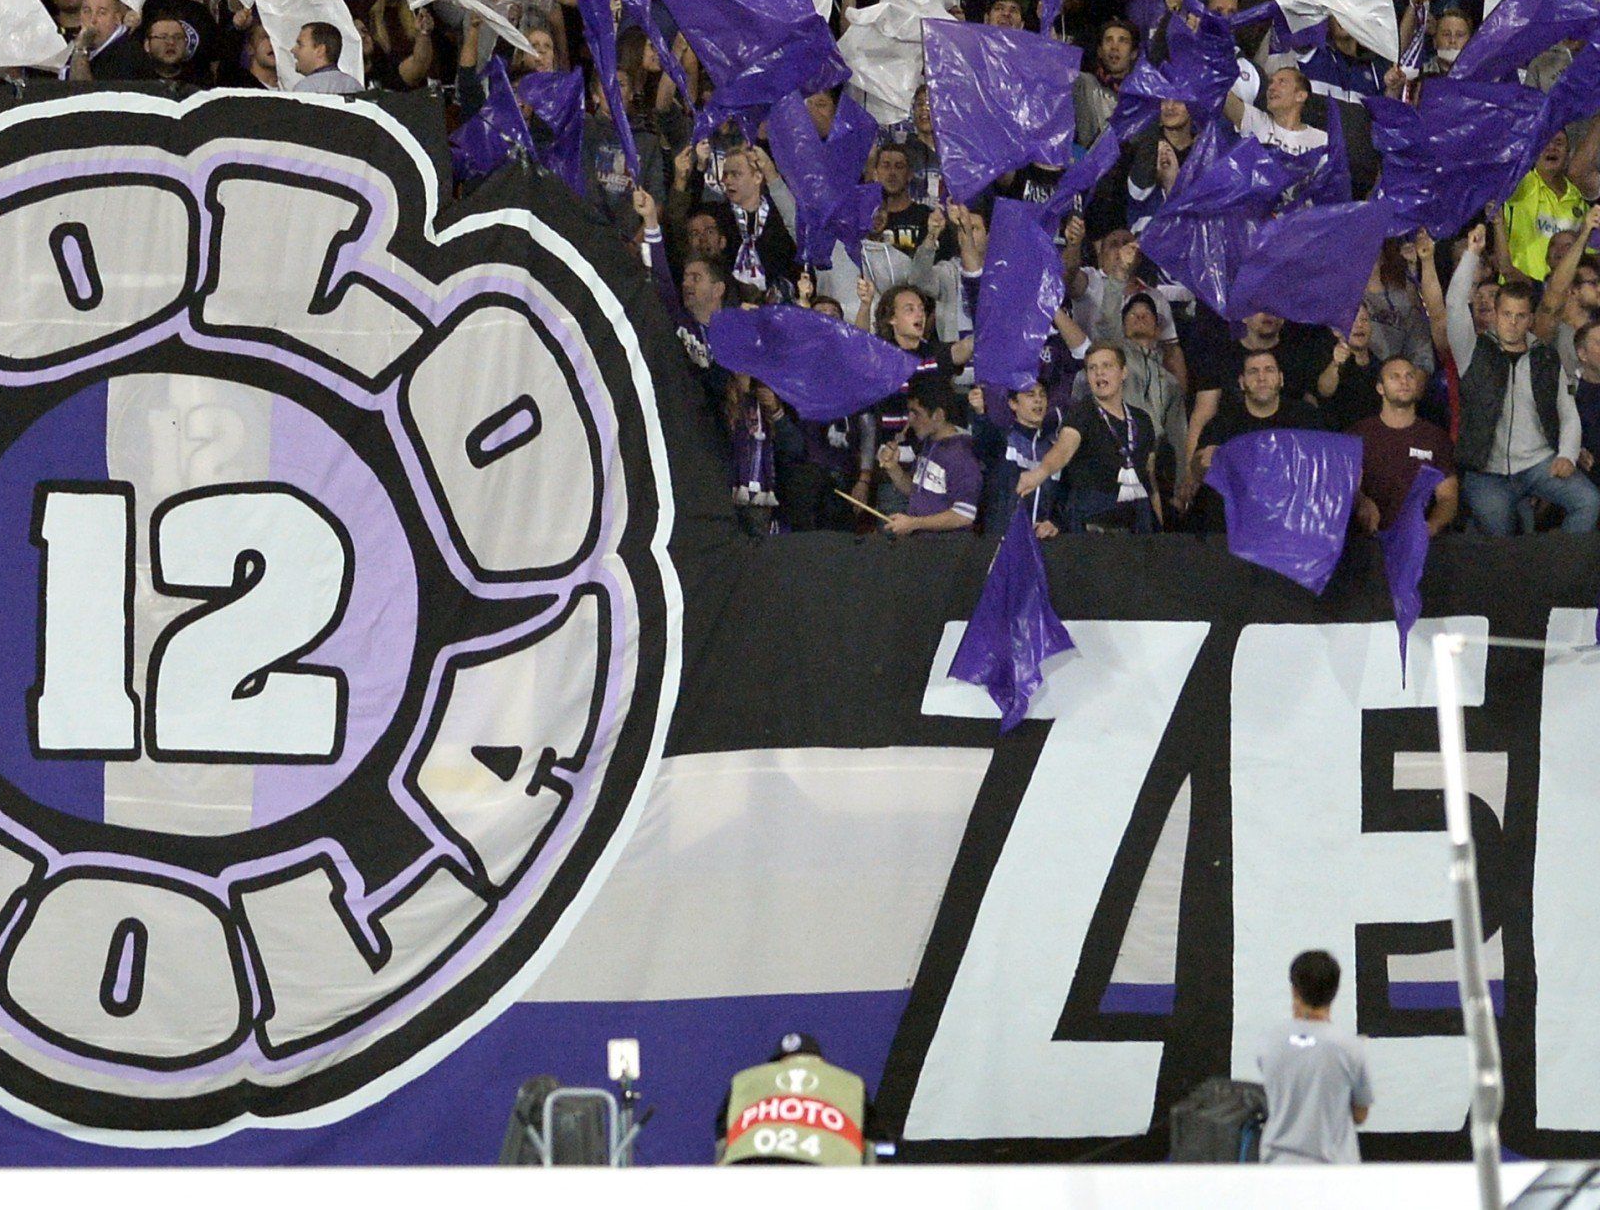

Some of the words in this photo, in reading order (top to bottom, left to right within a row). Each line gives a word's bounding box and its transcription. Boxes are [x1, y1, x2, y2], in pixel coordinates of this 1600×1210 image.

[32, 480, 355, 763] 12
[741, 1098, 845, 1131] PHOTO
[754, 1127, 821, 1157] 024
